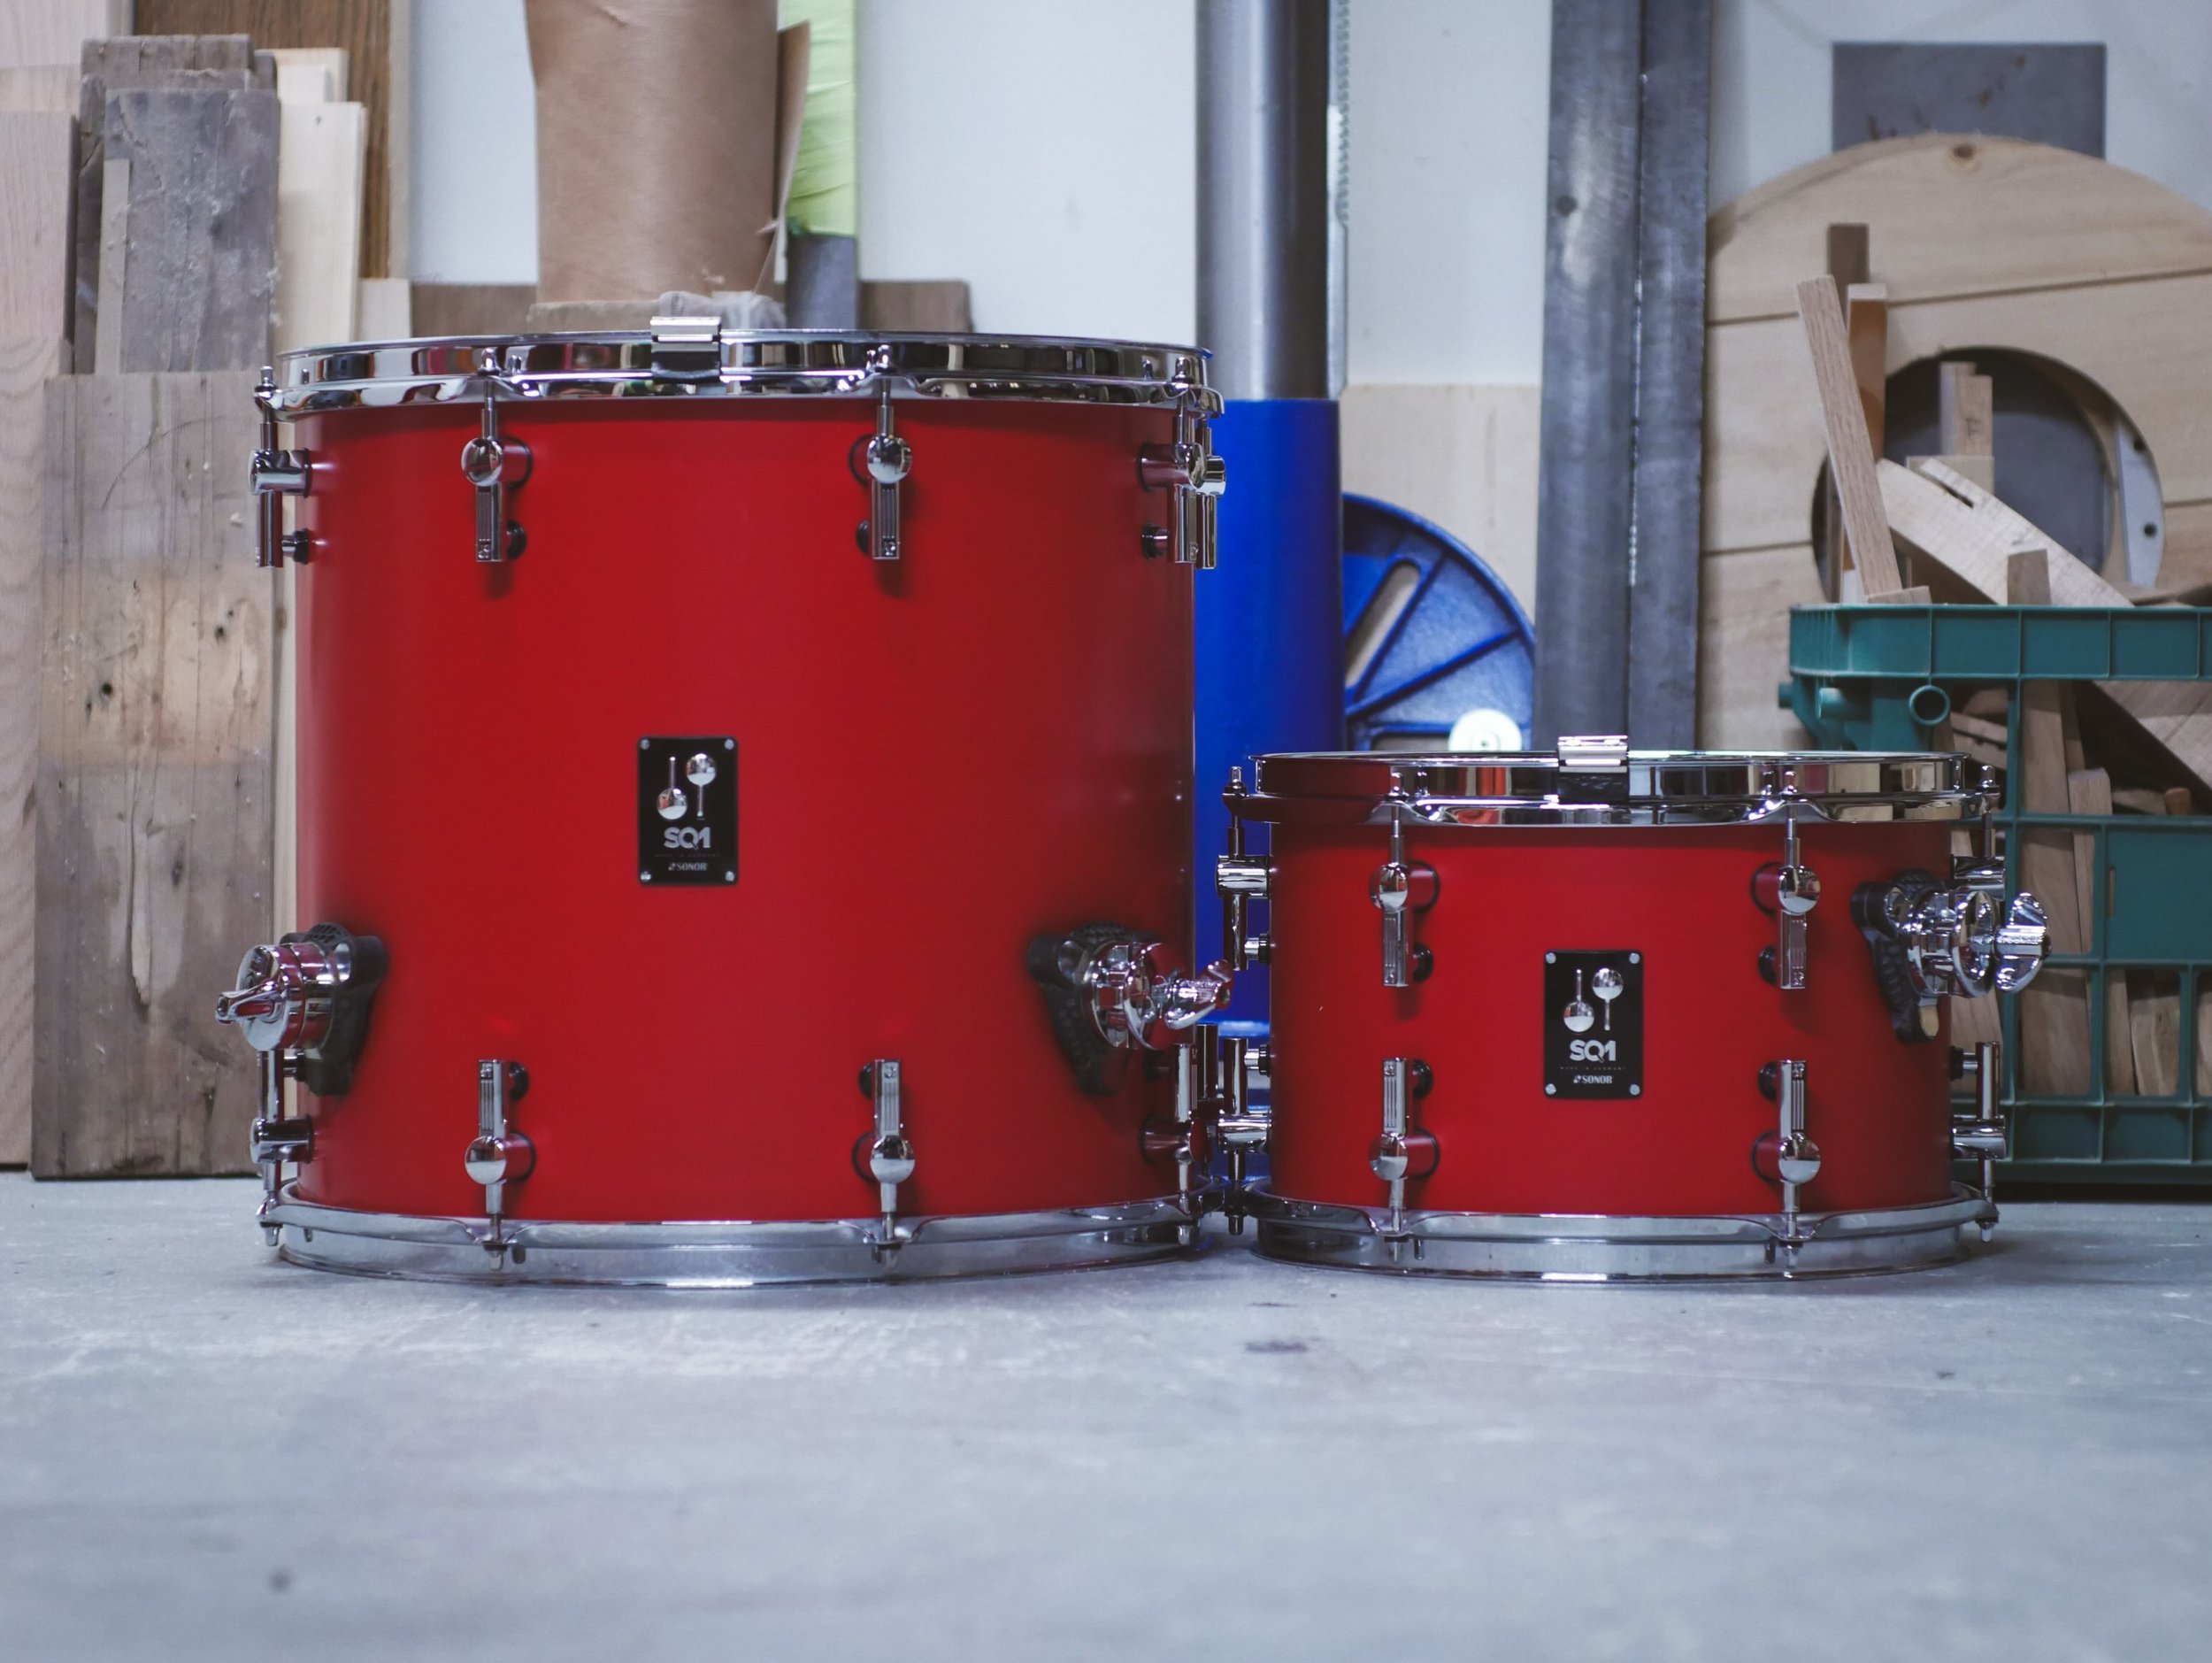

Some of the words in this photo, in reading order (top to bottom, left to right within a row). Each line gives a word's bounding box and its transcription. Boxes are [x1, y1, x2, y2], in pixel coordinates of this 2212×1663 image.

[664, 827, 710, 851] SQ1
[1570, 1039, 1617, 1063] SQ1
[1582, 1075, 1613, 1084] SONOR
